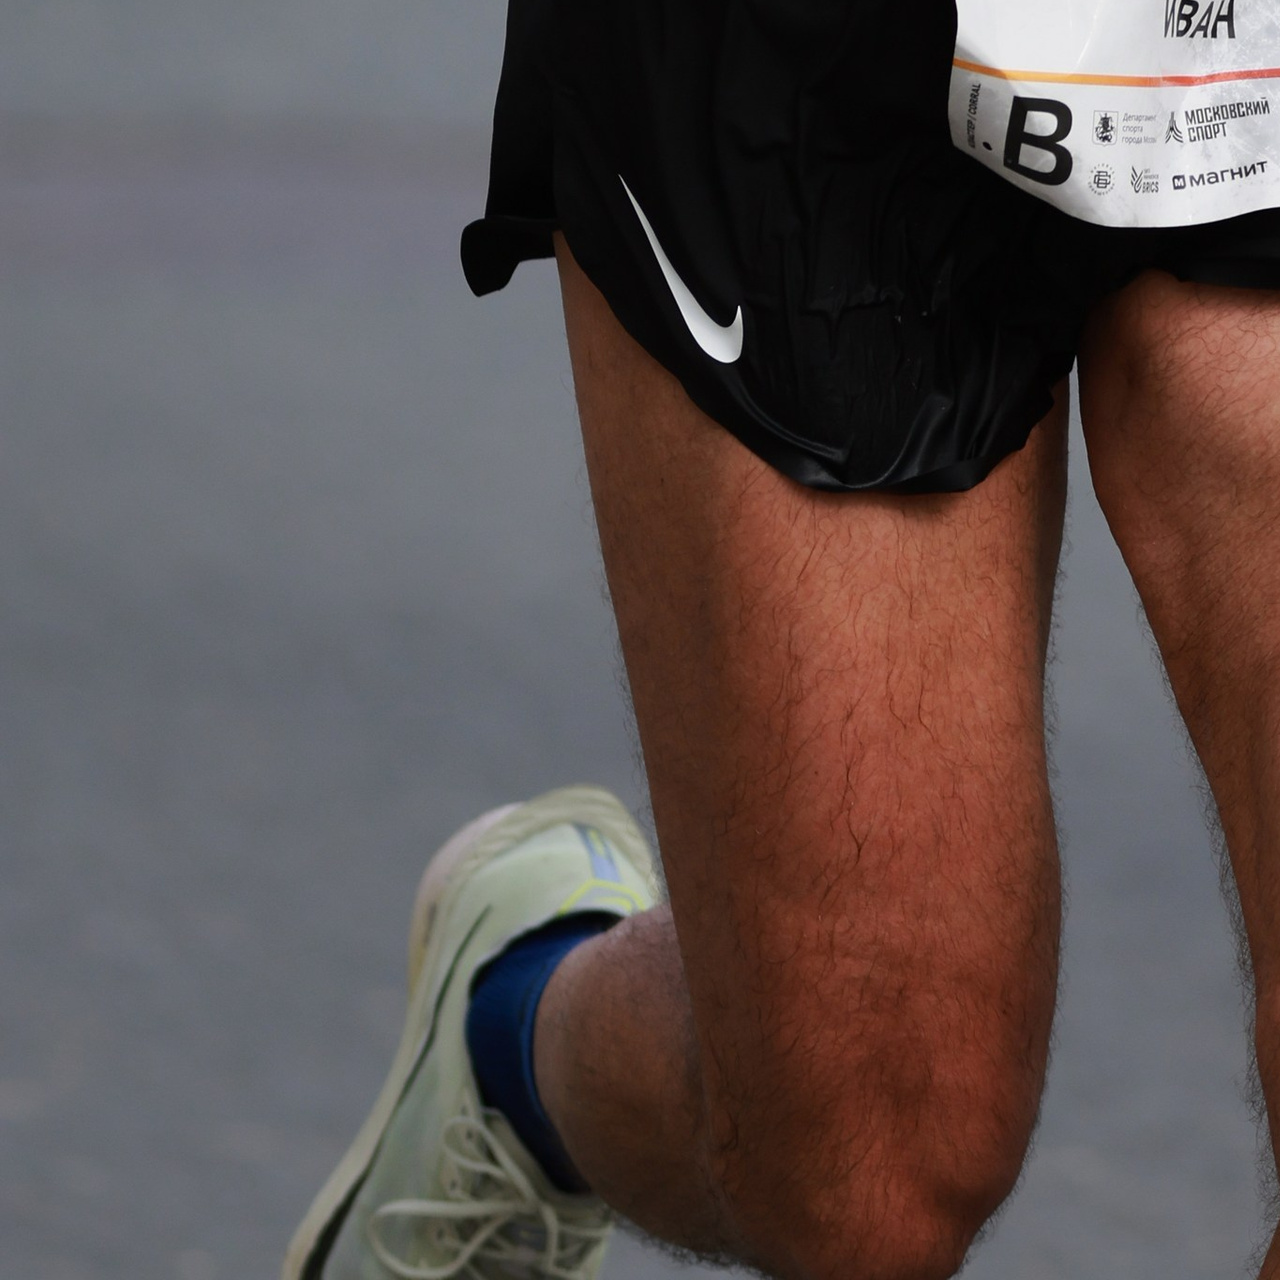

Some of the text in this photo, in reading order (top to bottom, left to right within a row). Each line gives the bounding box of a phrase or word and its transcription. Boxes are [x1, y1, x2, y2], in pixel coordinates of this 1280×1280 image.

[968, 83, 981, 115] CORRAL
[1184, 96, 1270, 126] МОСКОВСКИЙ
[1187, 122, 1228, 143] СПОРТ
